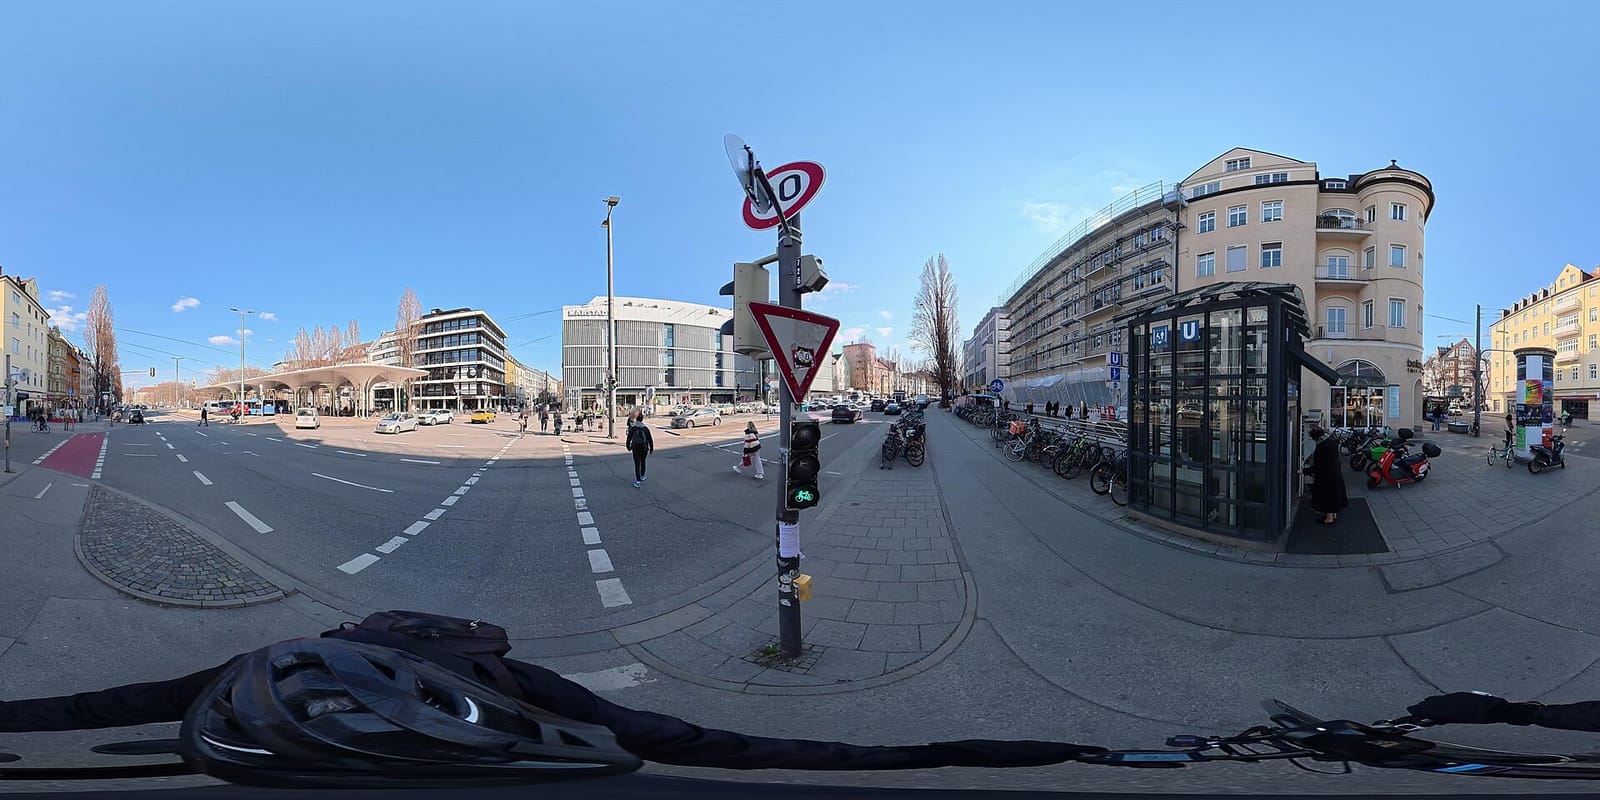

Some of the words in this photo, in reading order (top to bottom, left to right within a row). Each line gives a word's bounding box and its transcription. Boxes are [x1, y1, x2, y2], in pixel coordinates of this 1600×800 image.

[779, 174, 801, 201] 0
[1183, 321, 1196, 340] U
[1112, 353, 1119, 364] U
